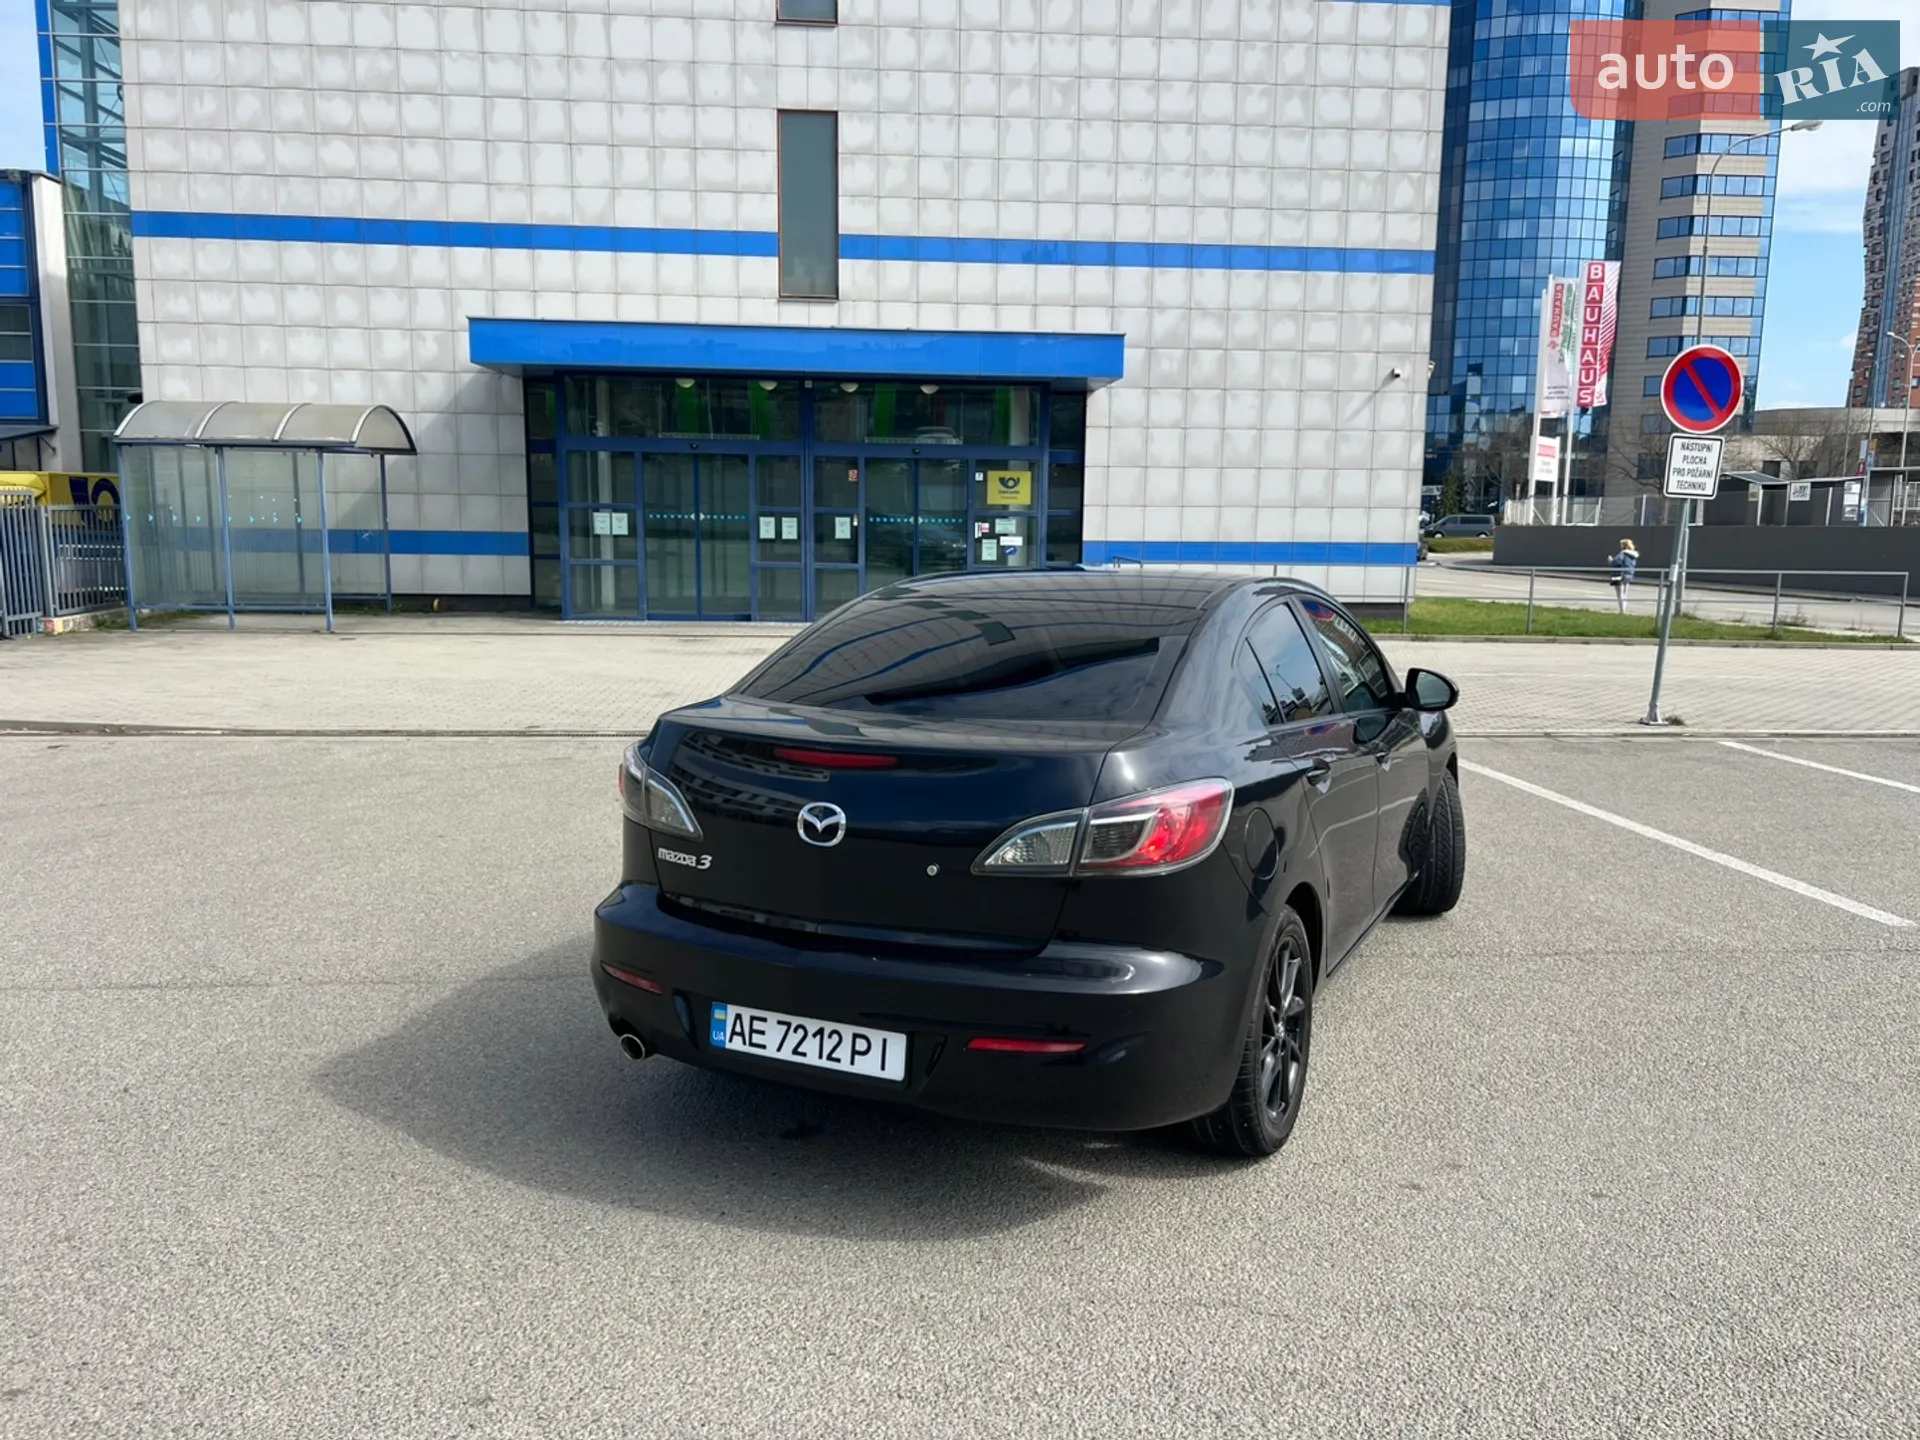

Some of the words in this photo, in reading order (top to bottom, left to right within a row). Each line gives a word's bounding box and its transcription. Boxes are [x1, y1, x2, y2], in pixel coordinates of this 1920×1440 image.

[1577, 263, 1605, 405] BAUHAUS
[697, 854, 713, 869] 3
[713, 1030, 725, 1041] UA
[728, 1013, 767, 1050] AE
[776, 1020, 843, 1063] 7212
[850, 1032, 887, 1071] PI
